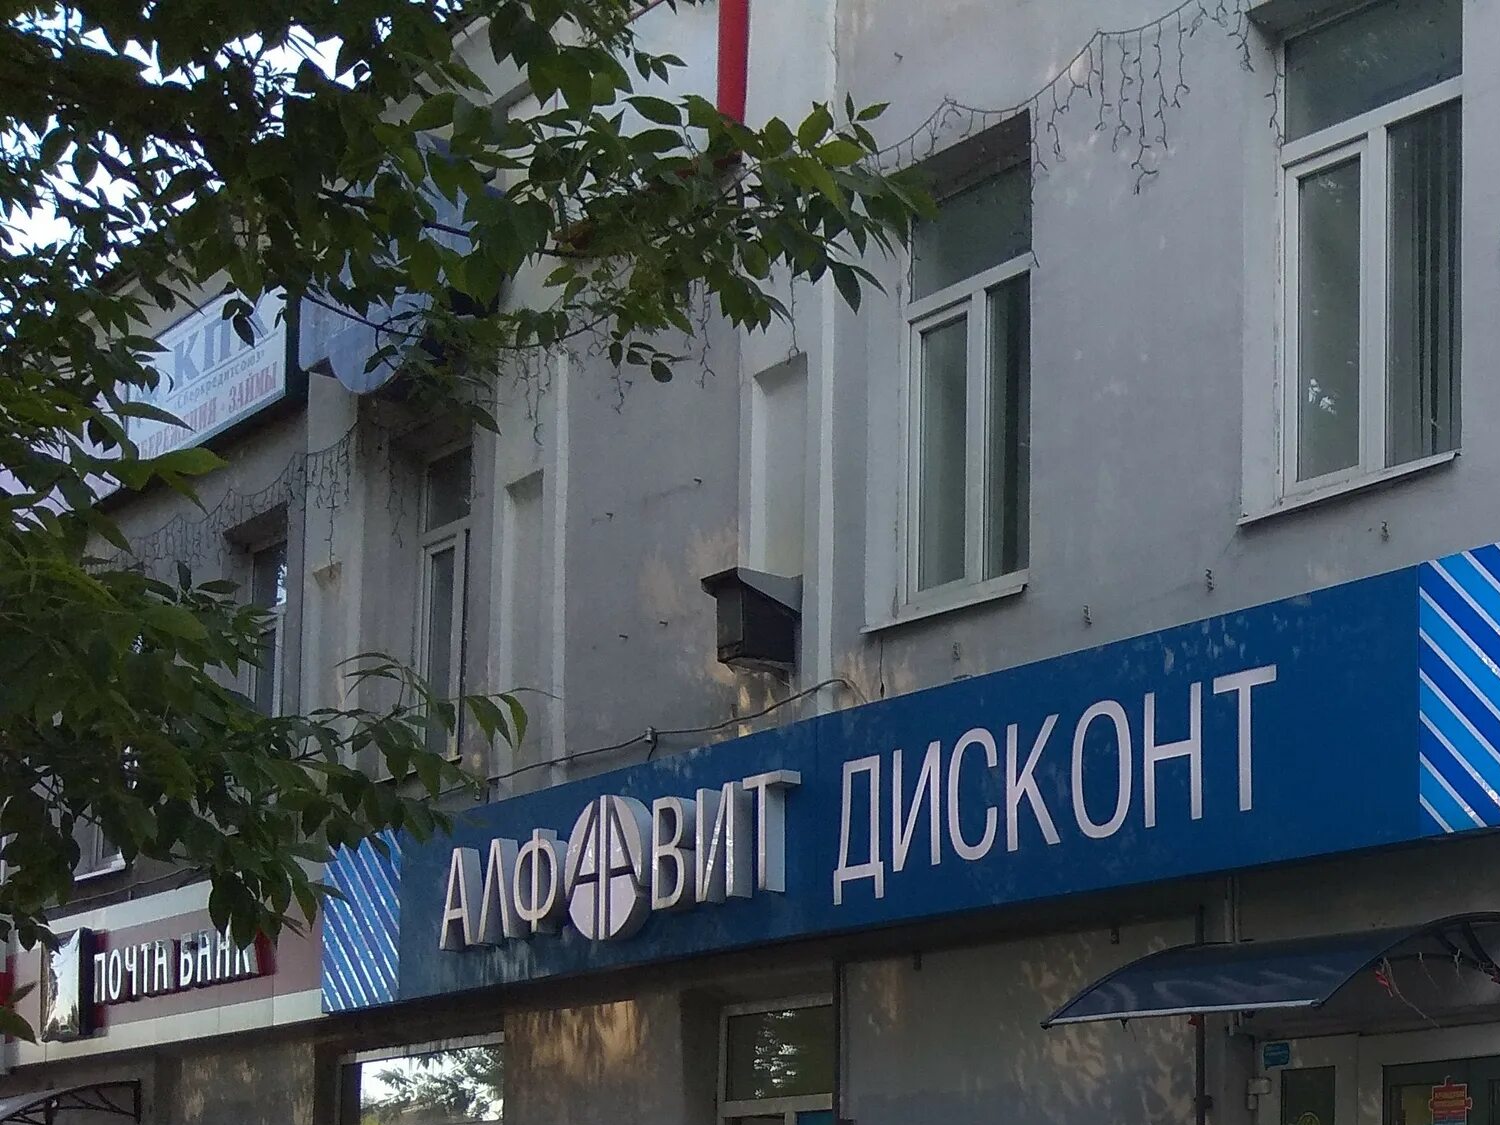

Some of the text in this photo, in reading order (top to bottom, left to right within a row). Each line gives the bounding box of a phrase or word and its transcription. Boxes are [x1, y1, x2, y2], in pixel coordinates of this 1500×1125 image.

[440, 664, 1277, 951] АЛФАВИТ ДИСКОНТ
[94, 938, 170, 1003] ПОЧТА
